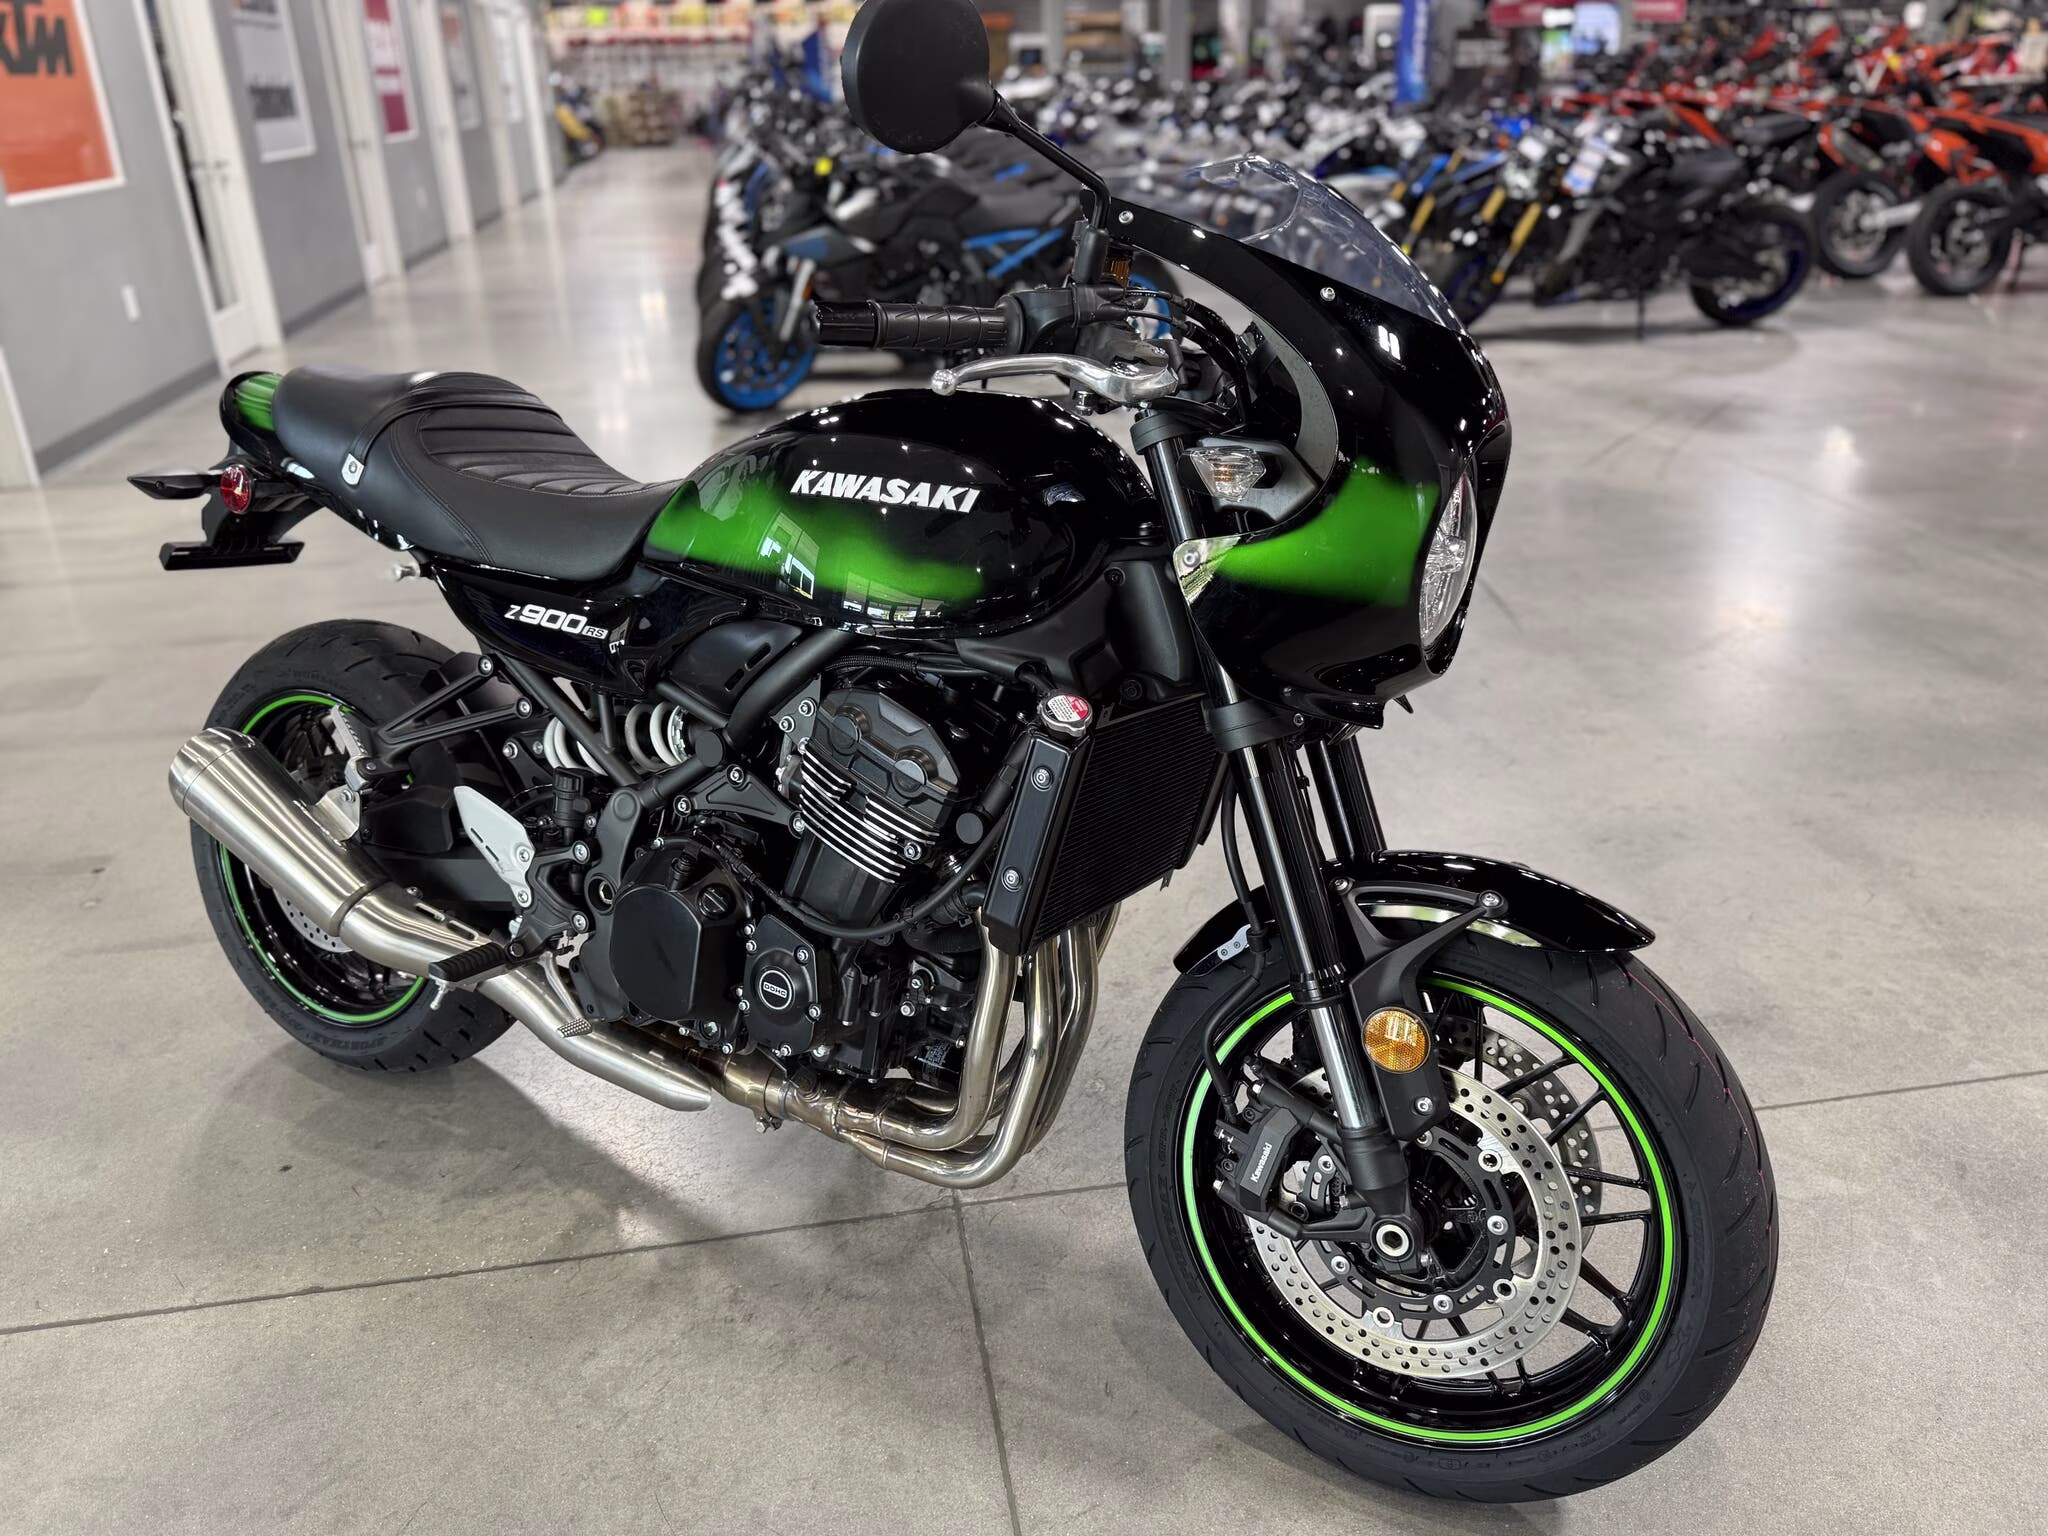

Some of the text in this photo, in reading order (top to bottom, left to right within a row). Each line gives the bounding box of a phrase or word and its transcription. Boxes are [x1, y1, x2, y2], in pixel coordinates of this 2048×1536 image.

[789, 468, 981, 514] KAWASAKI
[764, 983, 786, 997] DOHC
[1250, 1141, 1273, 1183] Kawasaki
